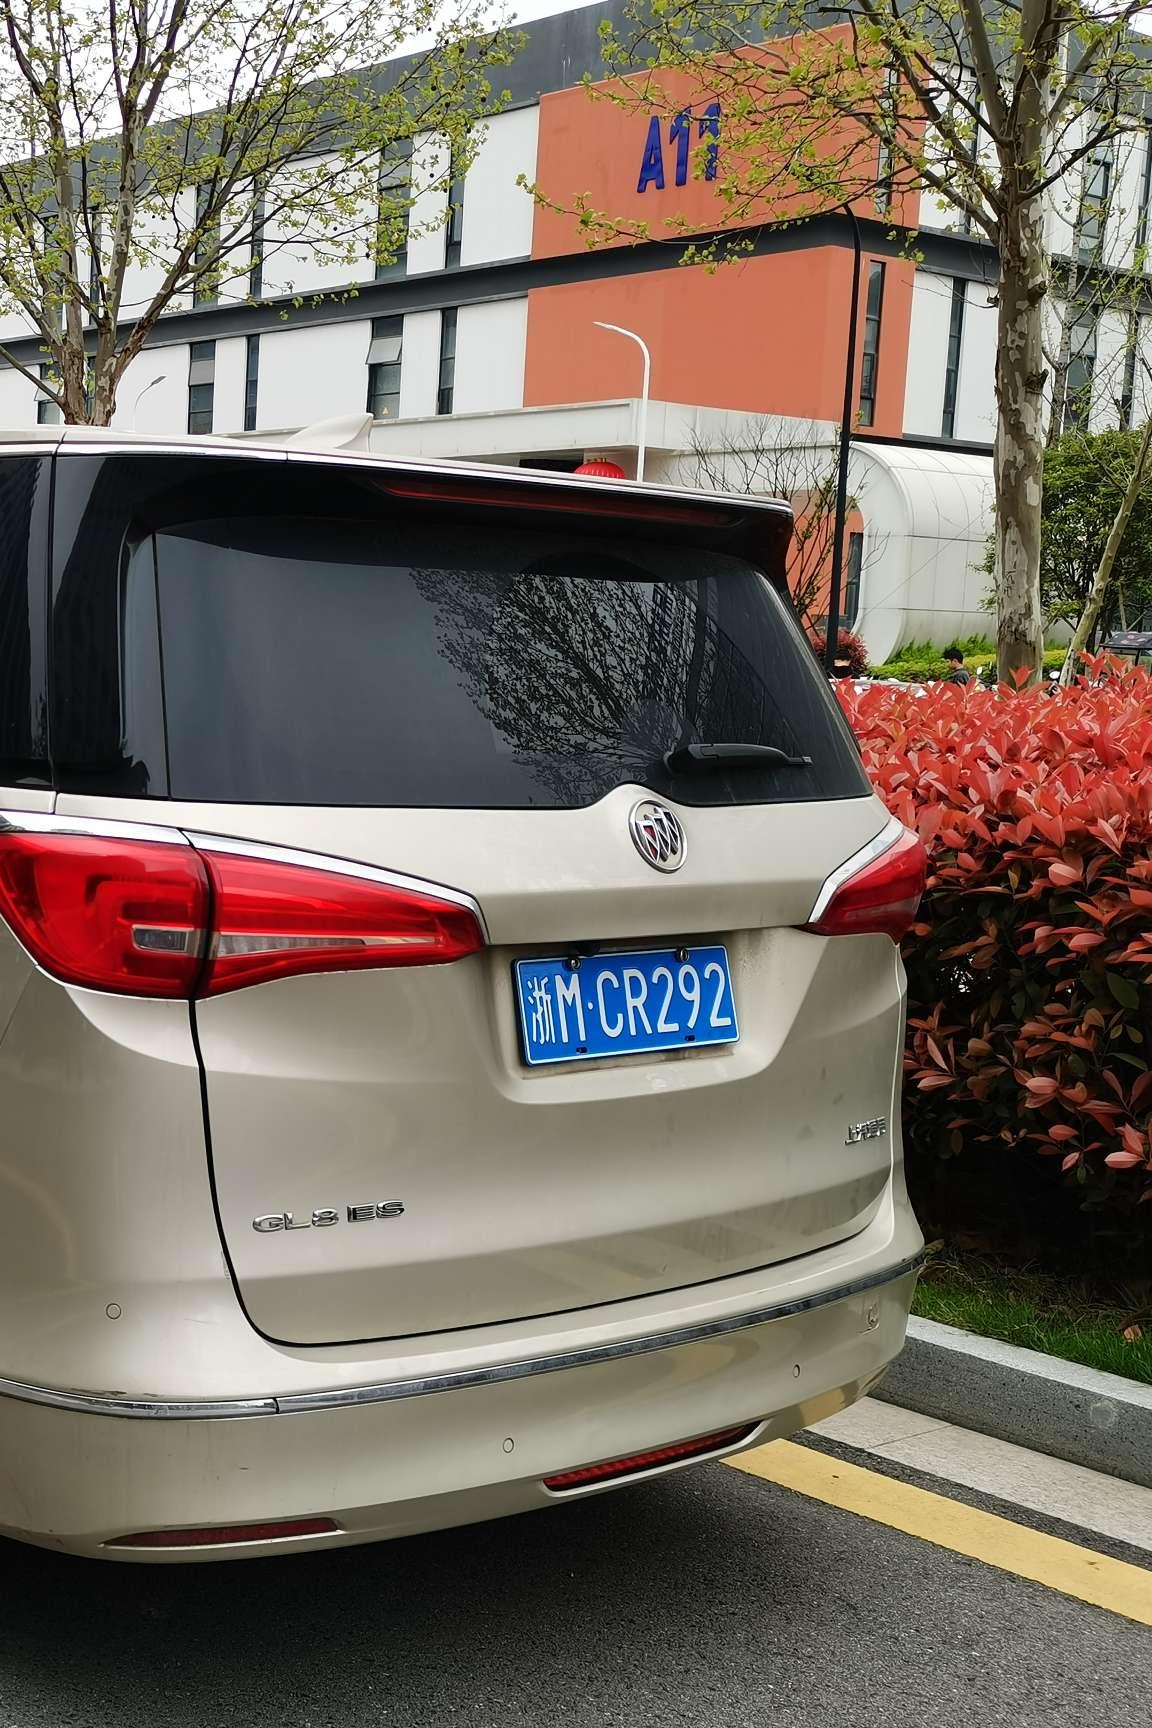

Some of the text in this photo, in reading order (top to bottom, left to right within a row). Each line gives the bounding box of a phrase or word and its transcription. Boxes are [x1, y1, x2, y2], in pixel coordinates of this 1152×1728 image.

[637, 103, 721, 193] A11
[528, 963, 732, 1044] 浙M·CR292
[252, 1199, 405, 1233] GL8 ES
